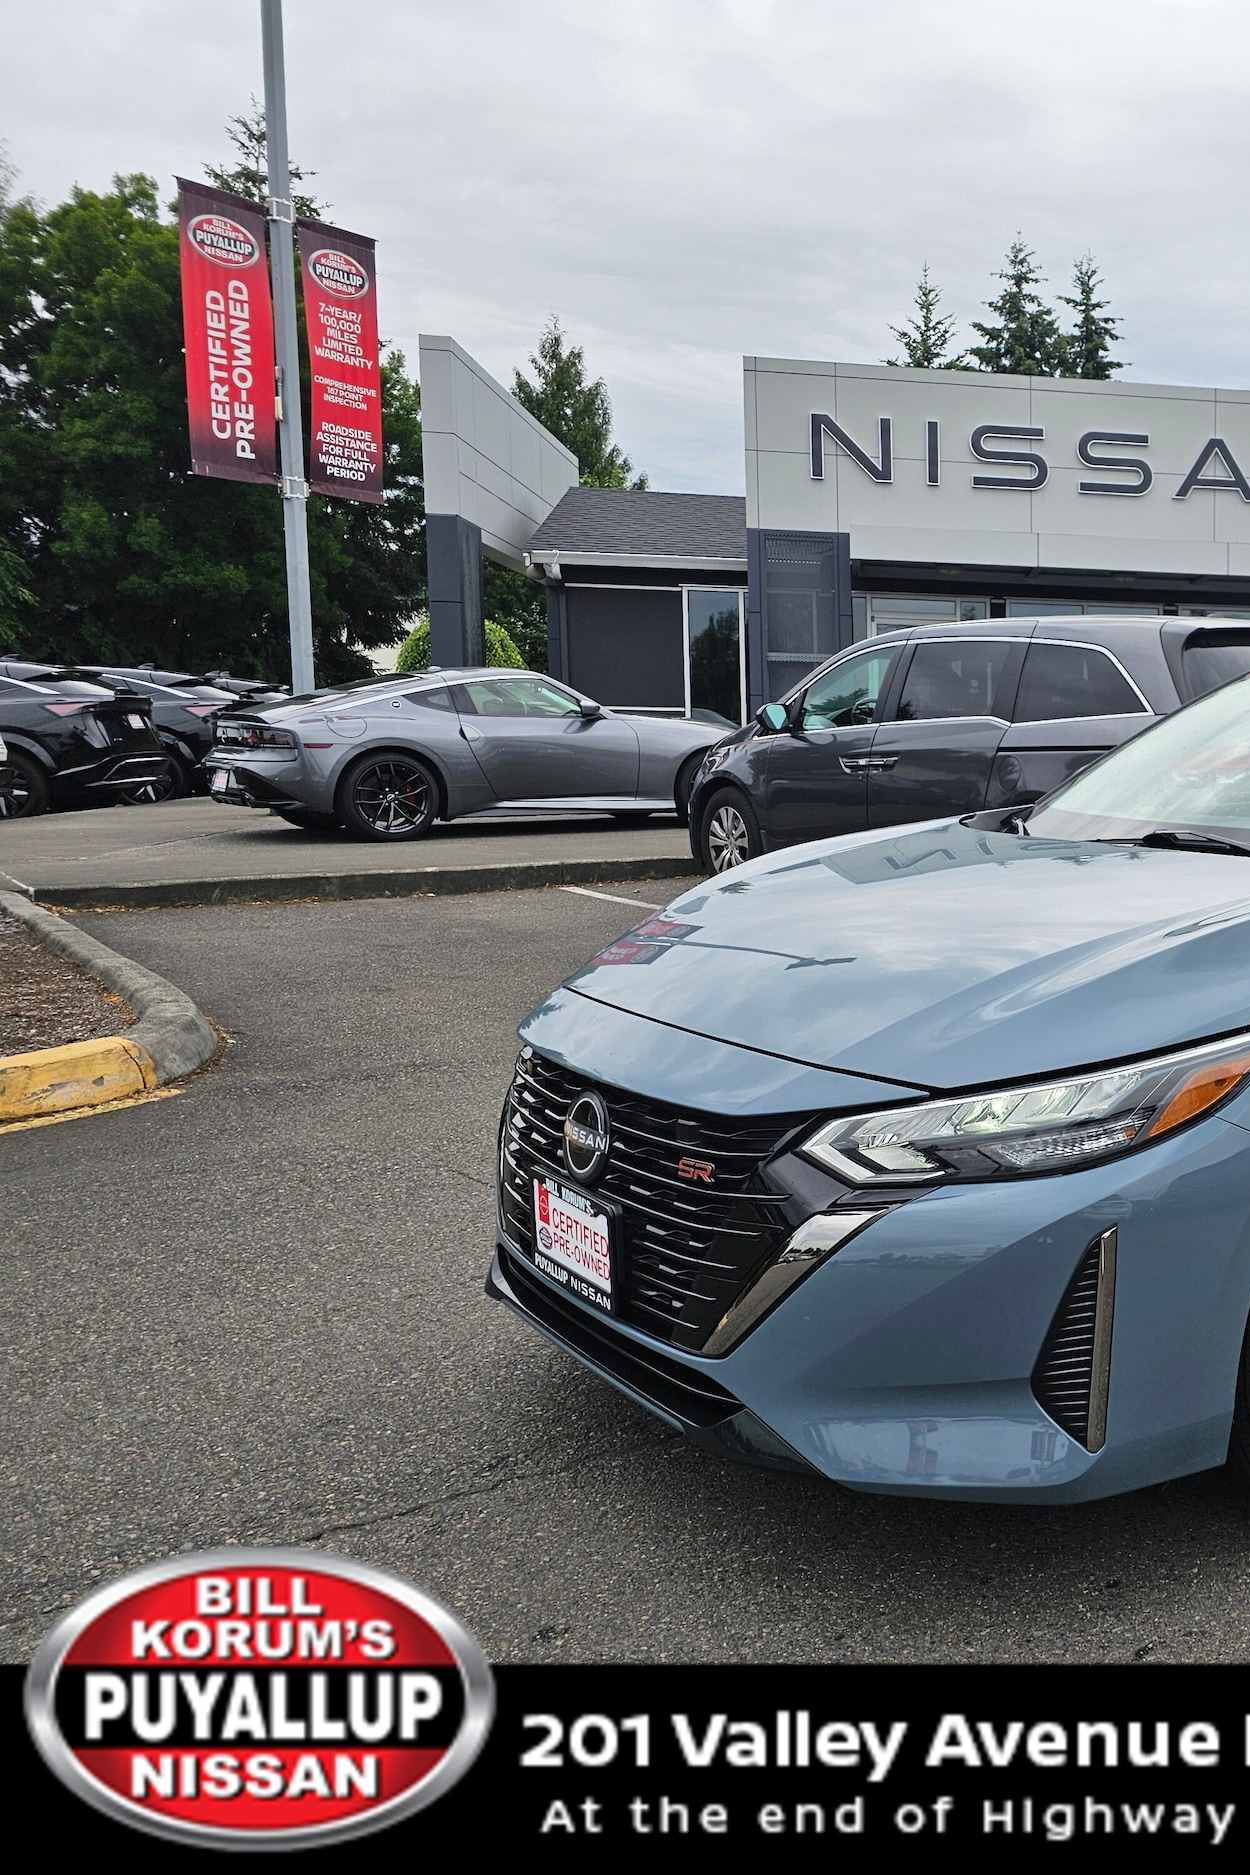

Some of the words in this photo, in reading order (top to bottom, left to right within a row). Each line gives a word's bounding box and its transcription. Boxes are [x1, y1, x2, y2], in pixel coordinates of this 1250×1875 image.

[202, 222, 245, 241] KORUM'S
[212, 218, 232, 231] BILL
[195, 229, 253, 256] PUYALLUP
[204, 245, 243, 263] NISSAN
[328, 253, 346, 264] BILL
[315, 263, 363, 287] PUYALLUP
[320, 257, 357, 273] KORUM'S
[322, 278, 356, 294] NISSAN
[318, 302, 362, 324] 7-YEAR/
[318, 313, 362, 334] 100,000
[326, 327, 358, 344] MILES
[322, 337, 363, 356] LIMITED
[206, 290, 232, 440] CERTIFIED
[314, 345, 373, 370] WARRANTY
[228, 280, 256, 460] PRE-OWNED
[313, 374, 377, 398] COMPREHENSIVE
[326, 386, 339, 396] 167
[339, 390, 364, 402] POINT
[323, 393, 368, 411] INSPECTION
[321, 421, 372, 441] ROADSIDE
[316, 431, 378, 453] ASSISTANCE
[322, 443, 343, 457] FOR
[343, 448, 370, 462] FULL
[318, 452, 376, 473] WARRANTY
[326, 465, 366, 482] PERIOD
[564, 1121, 606, 1151] NISSAN
[677, 1156, 716, 1183] SR
[545, 1178, 559, 1197] BILL
[561, 1187, 594, 1217] KORUM'S
[552, 1207, 609, 1258] CERTIFIED
[553, 1232, 611, 1281] PRE-OWNED
[535, 1252, 569, 1285] PUYALLUP
[570, 1276, 611, 1311] NISSAN
